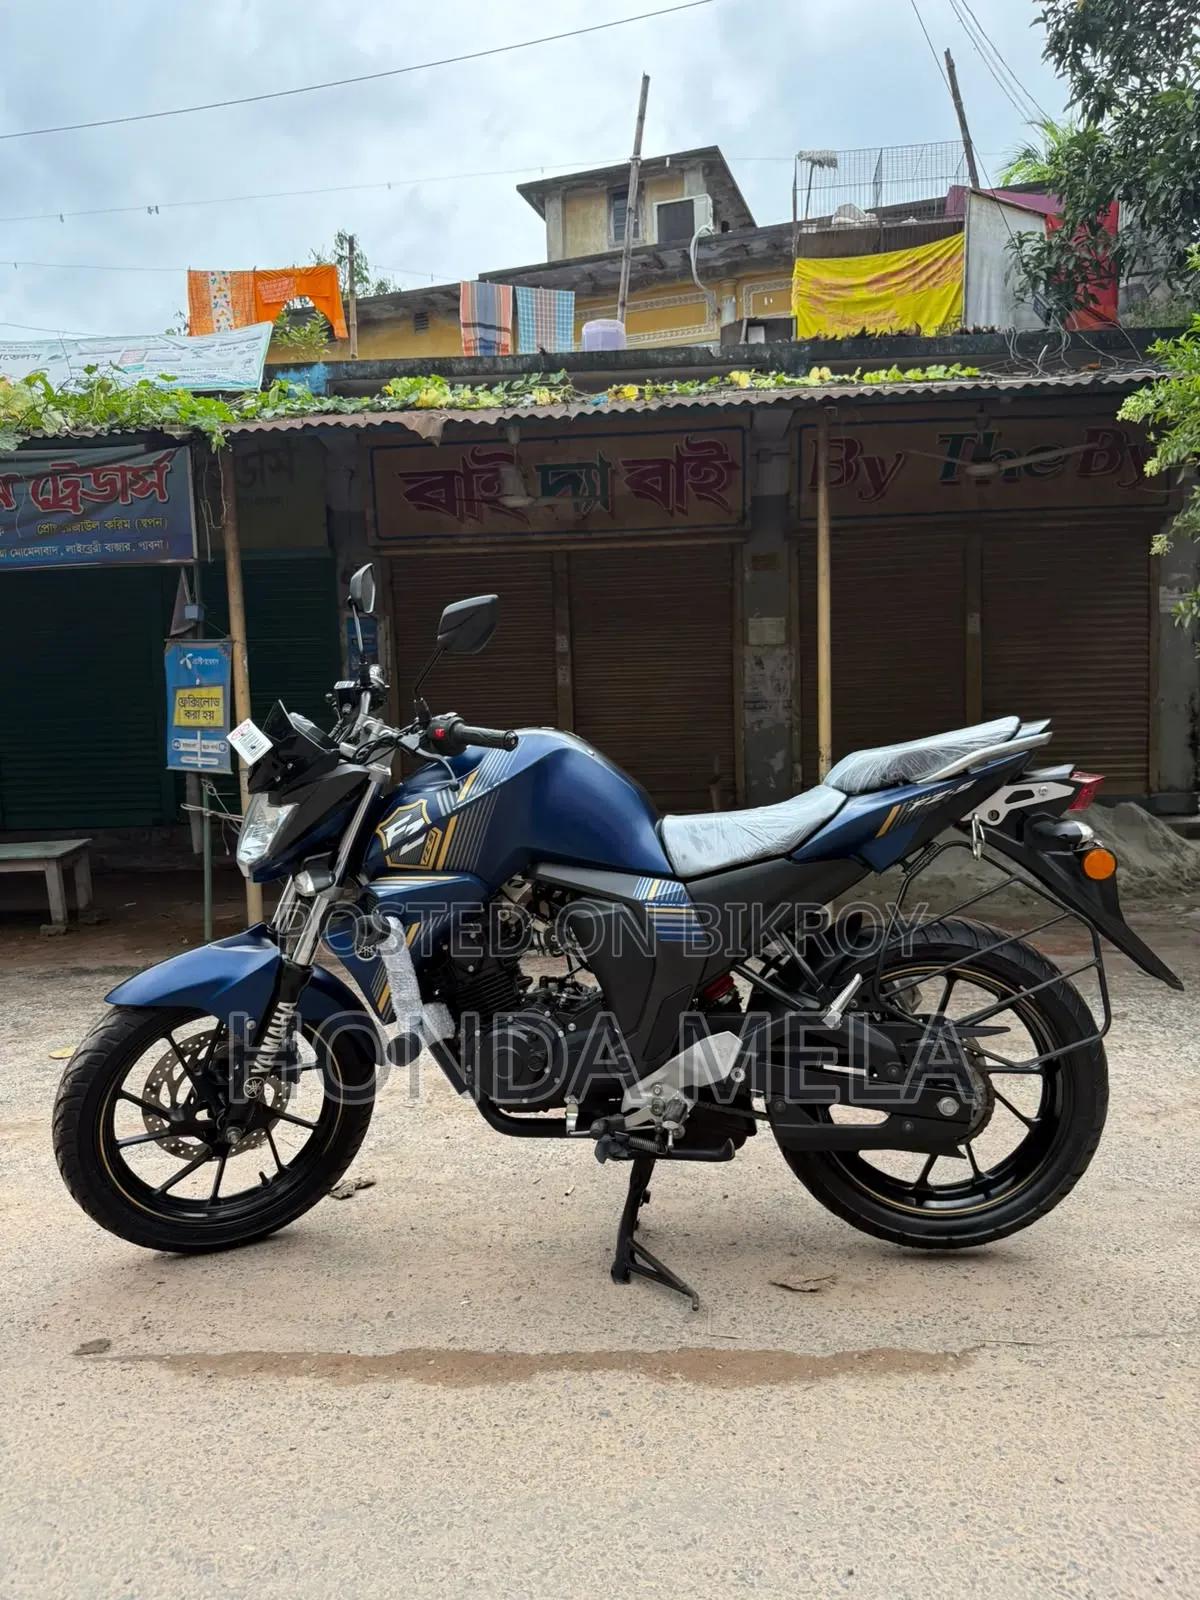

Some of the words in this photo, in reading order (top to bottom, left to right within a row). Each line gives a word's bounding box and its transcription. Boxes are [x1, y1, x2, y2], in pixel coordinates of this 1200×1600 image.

[29, 450, 176, 516] ট্রেডার্স
[621, 434, 741, 516] বাই
[809, 435, 906, 503] By
[937, 429, 1069, 486] The
[1077, 427, 1152, 489] By
[104, 516, 131, 531] করিম
[250, 1001, 297, 1074] YAMAHA
